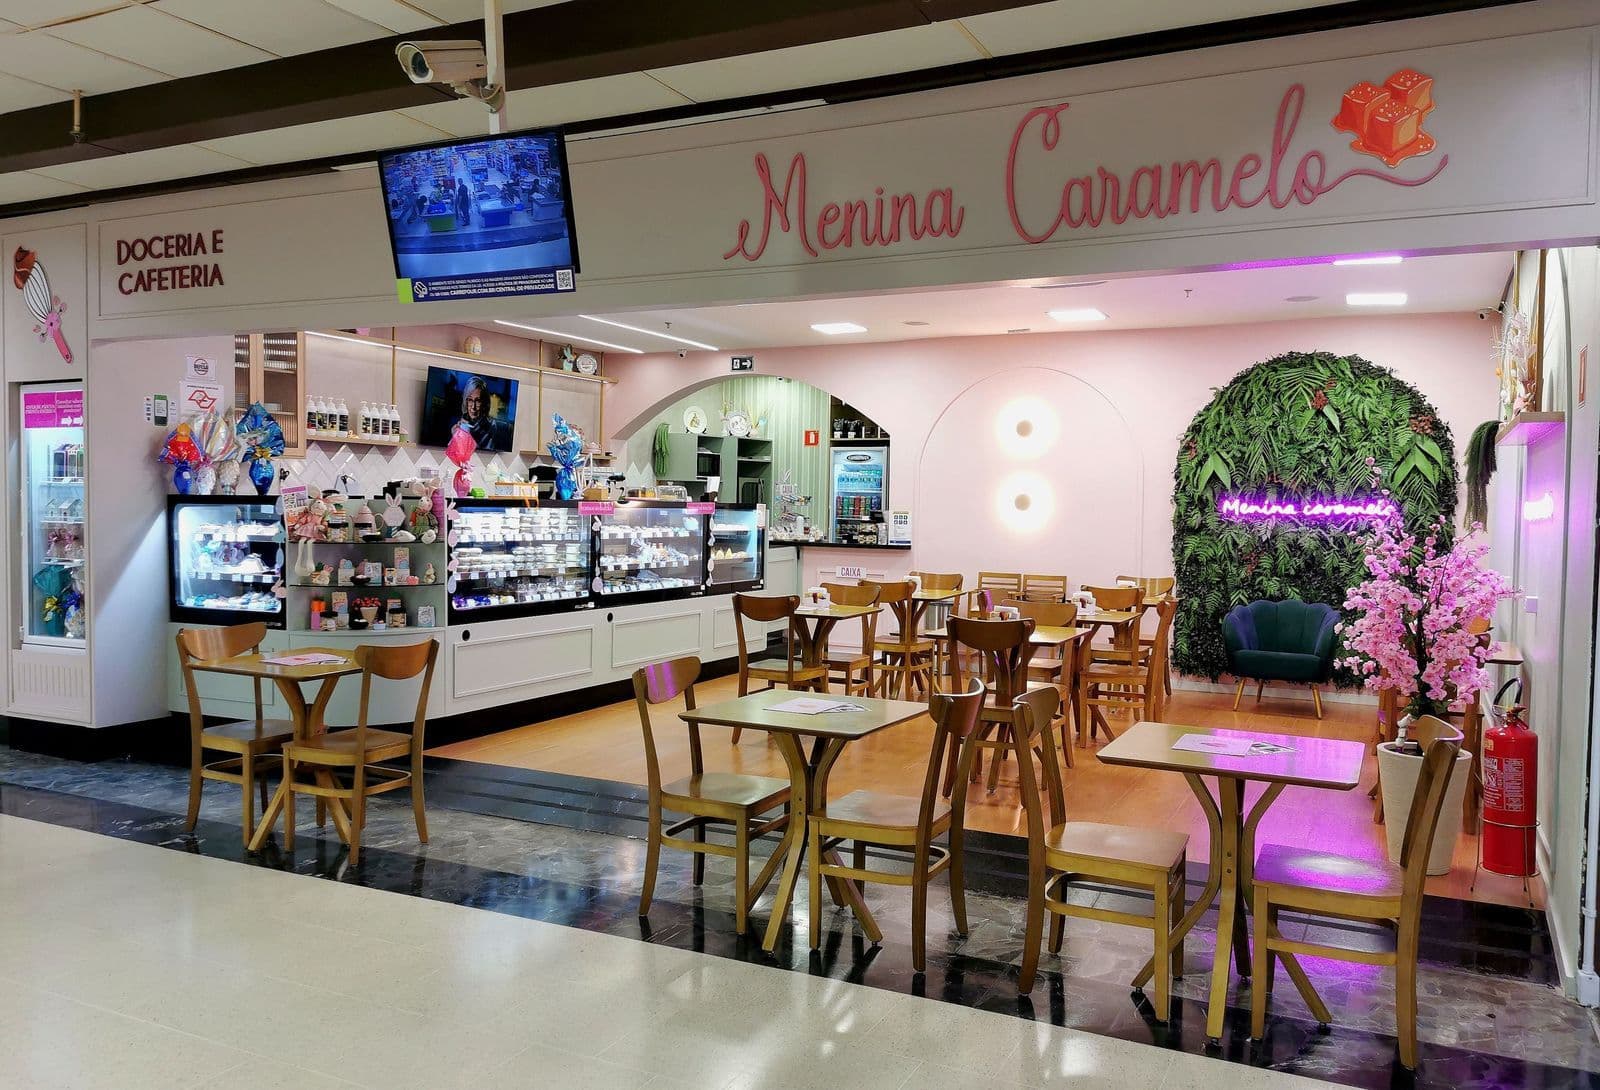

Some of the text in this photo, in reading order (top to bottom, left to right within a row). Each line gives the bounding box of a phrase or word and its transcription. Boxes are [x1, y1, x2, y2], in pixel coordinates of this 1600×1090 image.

[723, 83, 1449, 262] Menina Caramelo
[116, 229, 224, 266] DOCERIA E
[117, 263, 225, 296] CAFETERIA
[1222, 500, 1298, 516] Menina
[840, 566, 861, 577] CAIXA
